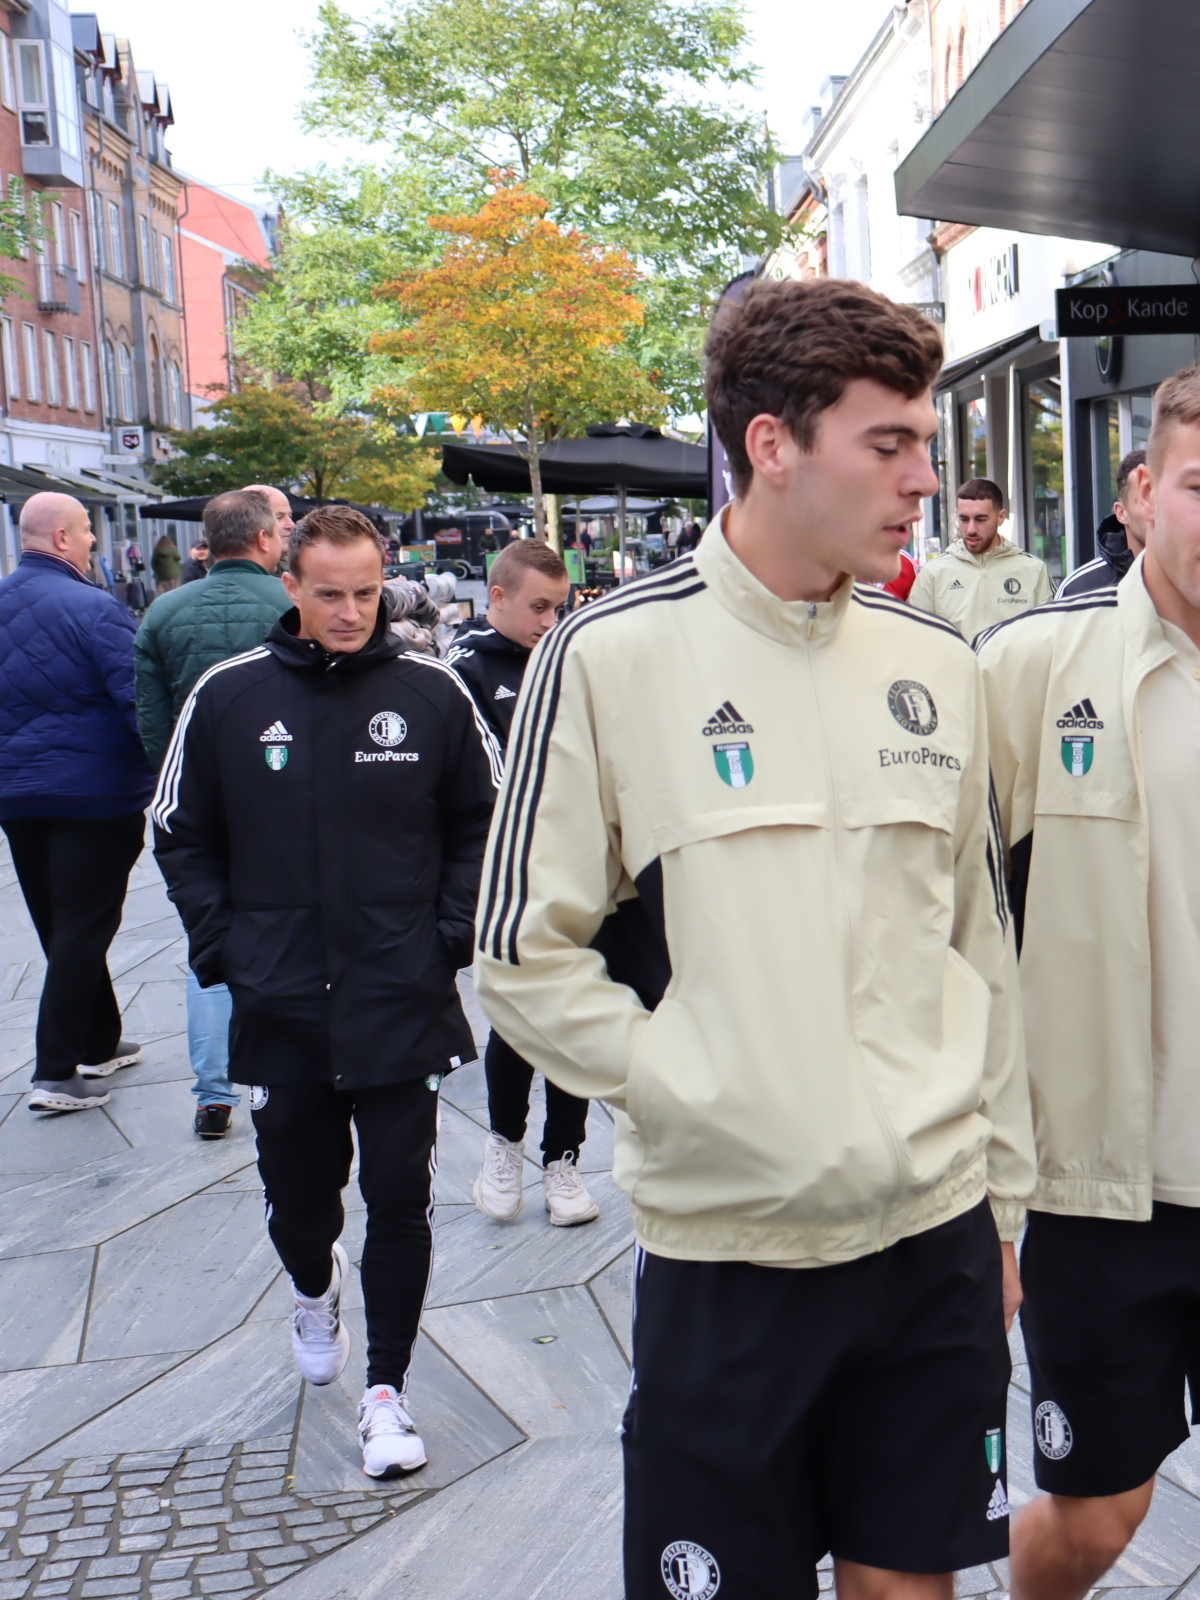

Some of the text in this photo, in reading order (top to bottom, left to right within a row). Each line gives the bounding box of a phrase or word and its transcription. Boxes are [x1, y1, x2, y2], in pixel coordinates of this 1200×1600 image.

[1070, 299, 1109, 323] Kop
[1127, 296, 1189, 318] Kande
[702, 721, 755, 737] adidas
[1056, 716, 1105, 730] adidas
[259, 732, 293, 742] adidas
[355, 750, 419, 763] EuroParcs
[878, 747, 961, 771] EuroParcs
